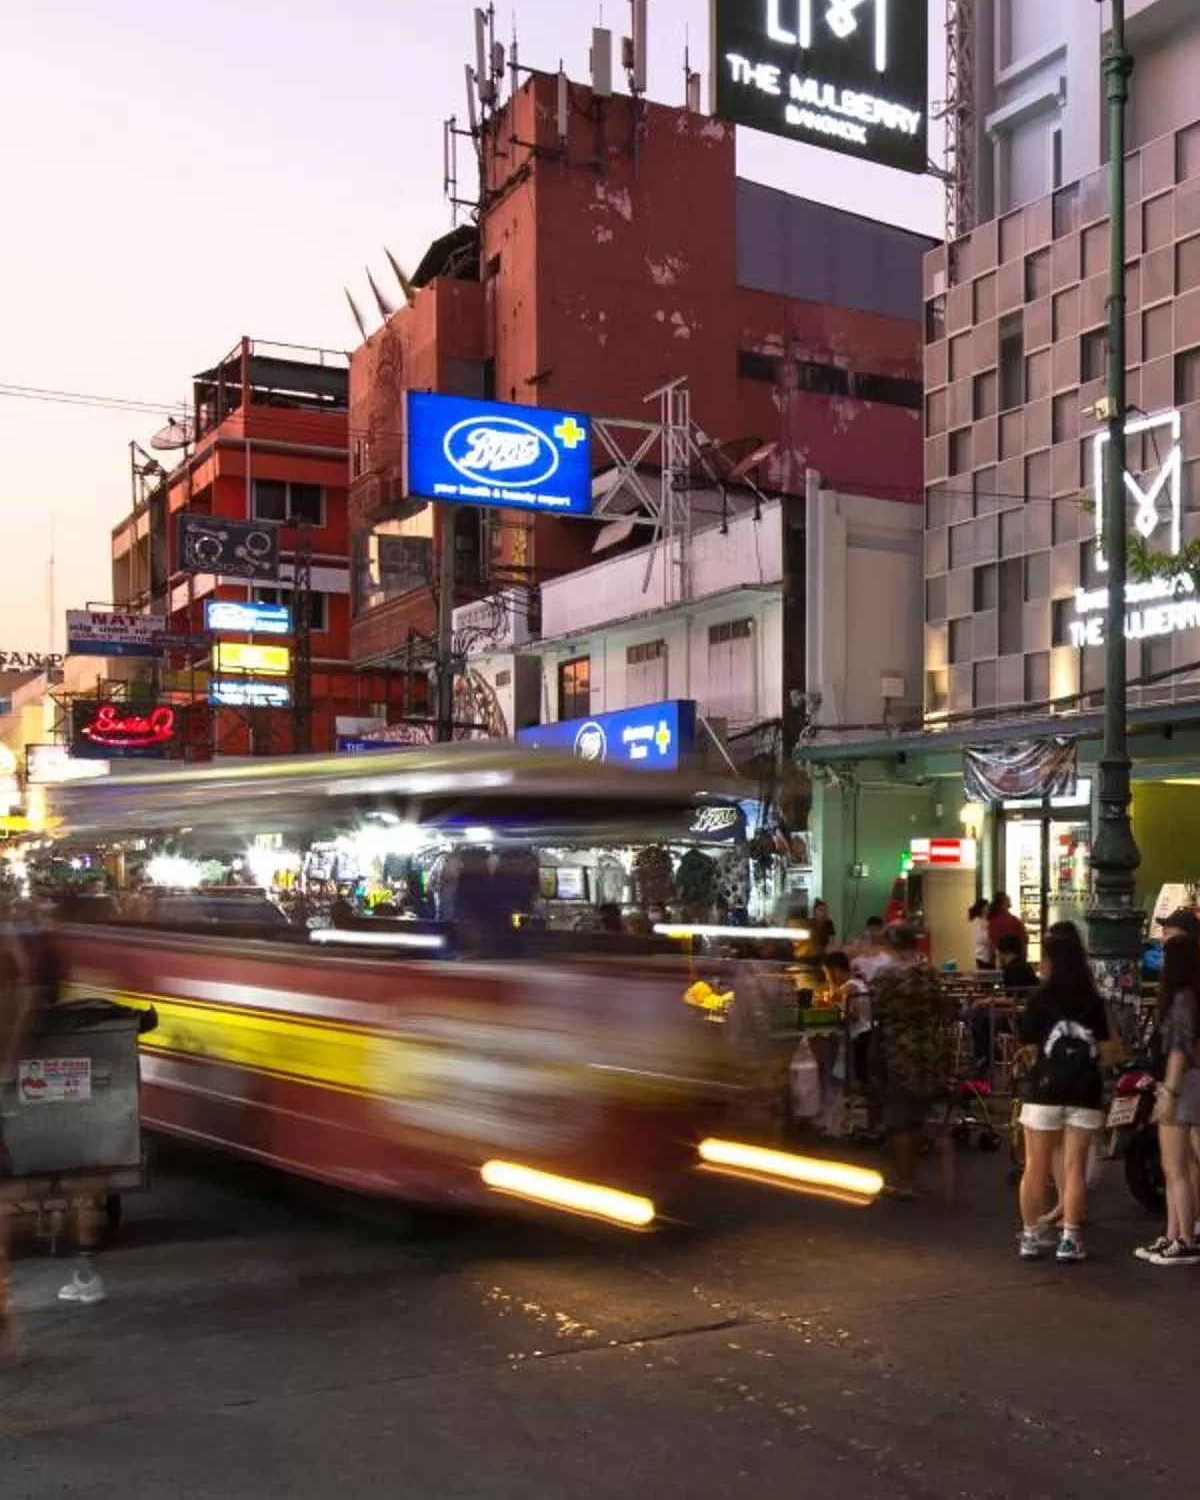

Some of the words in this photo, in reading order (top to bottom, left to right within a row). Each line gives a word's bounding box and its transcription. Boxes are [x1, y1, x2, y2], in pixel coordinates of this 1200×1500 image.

[725, 52, 781, 95] THE
[789, 73, 921, 135] MULBERRY
[1069, 616, 1105, 650] THE
